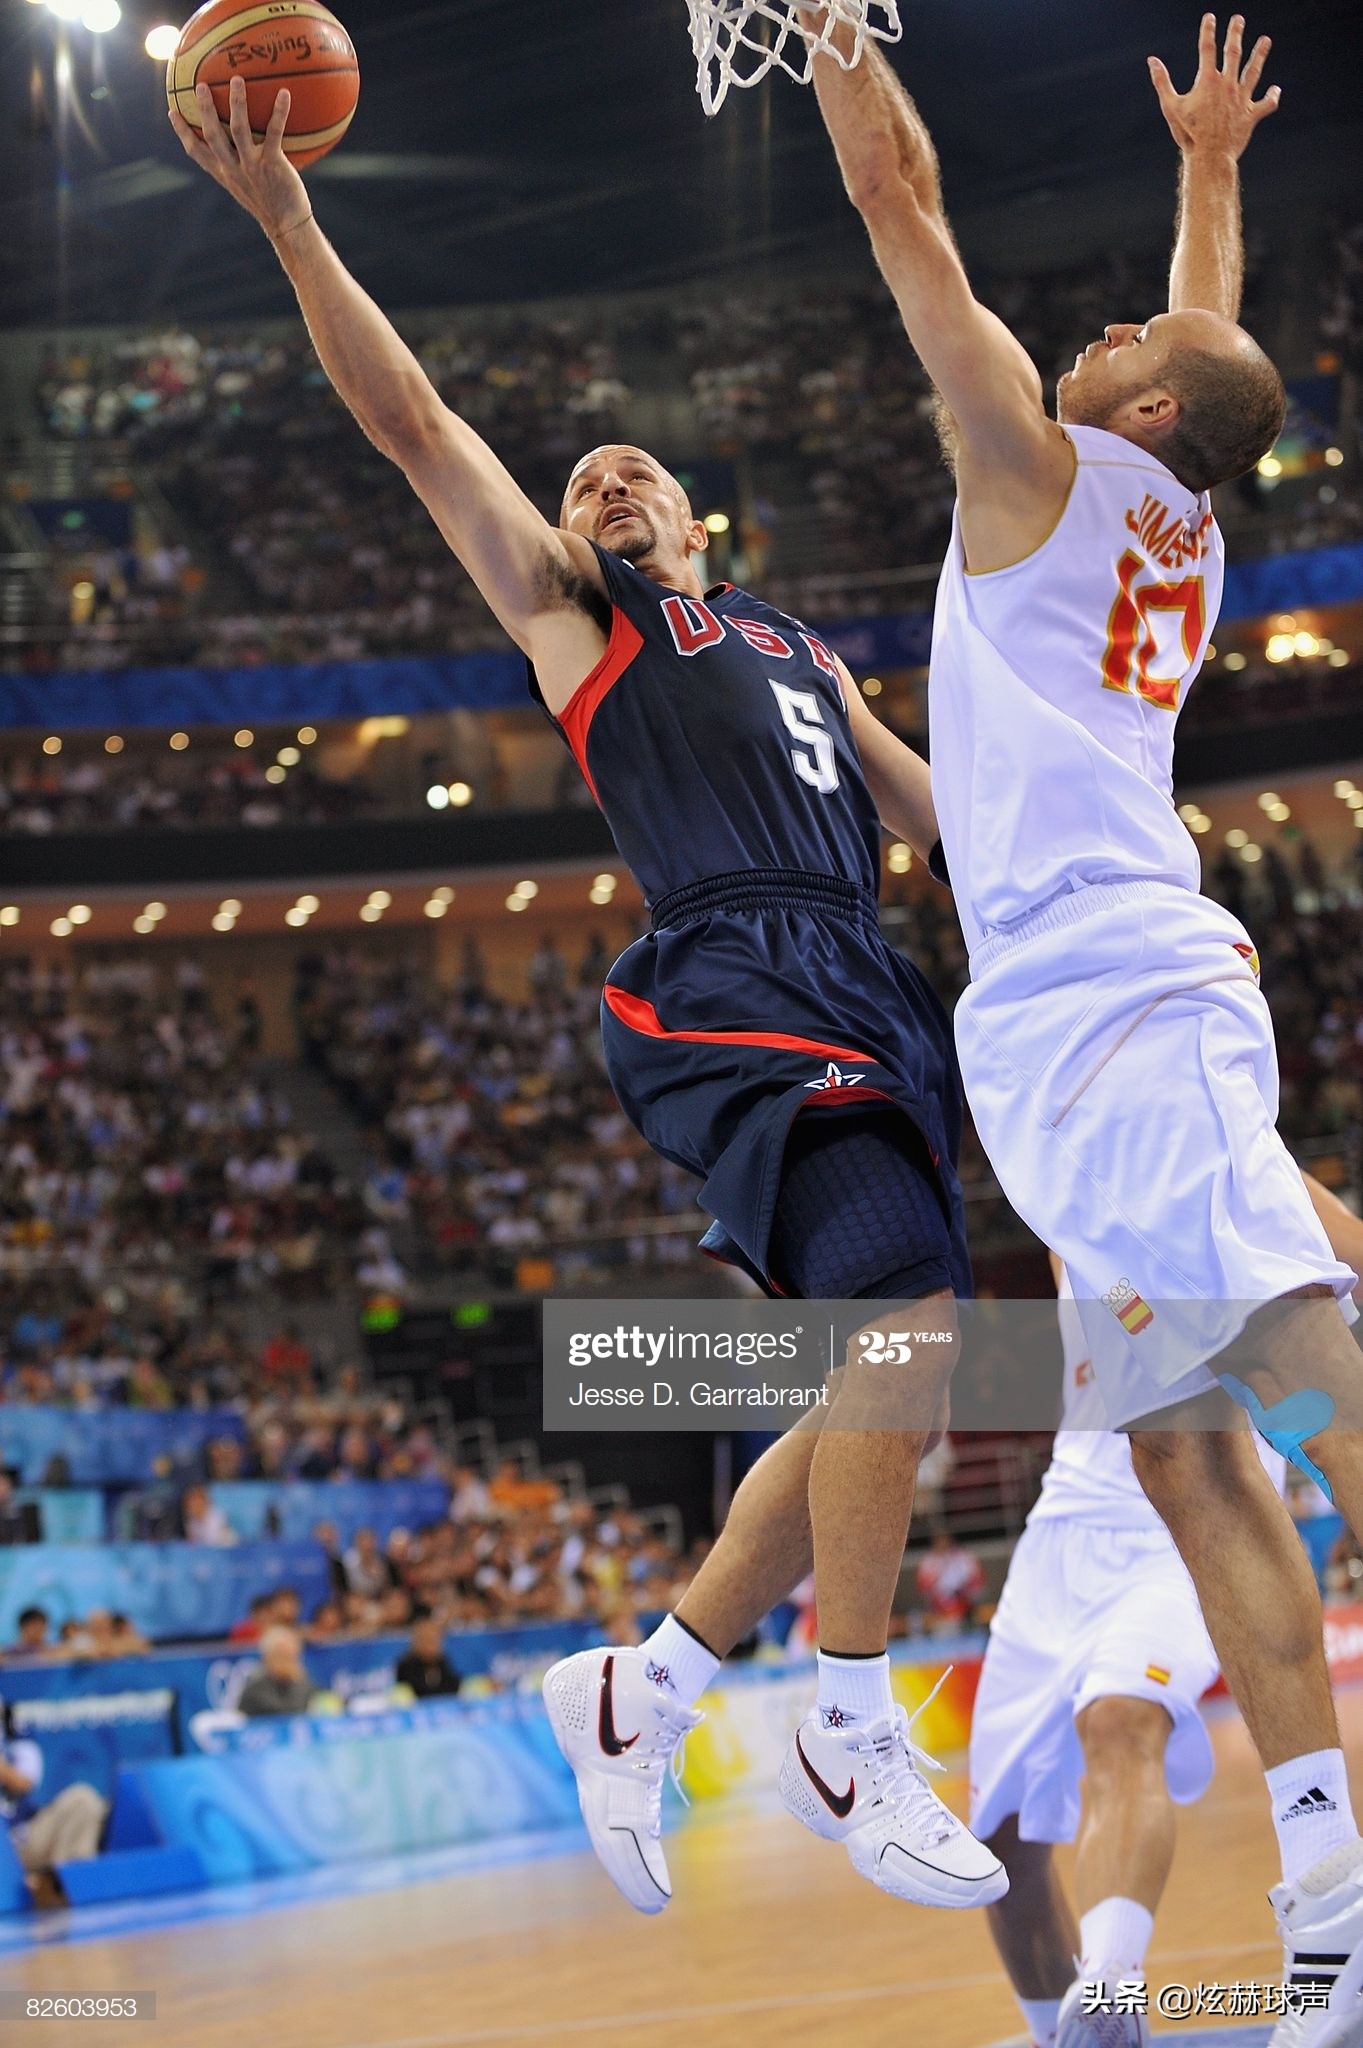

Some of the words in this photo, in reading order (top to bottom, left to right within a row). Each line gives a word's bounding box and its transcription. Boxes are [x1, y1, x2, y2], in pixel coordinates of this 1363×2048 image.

[219, 35, 311, 68] Beijing
[1102, 547, 1206, 712] 10
[768, 678, 840, 794] 5
